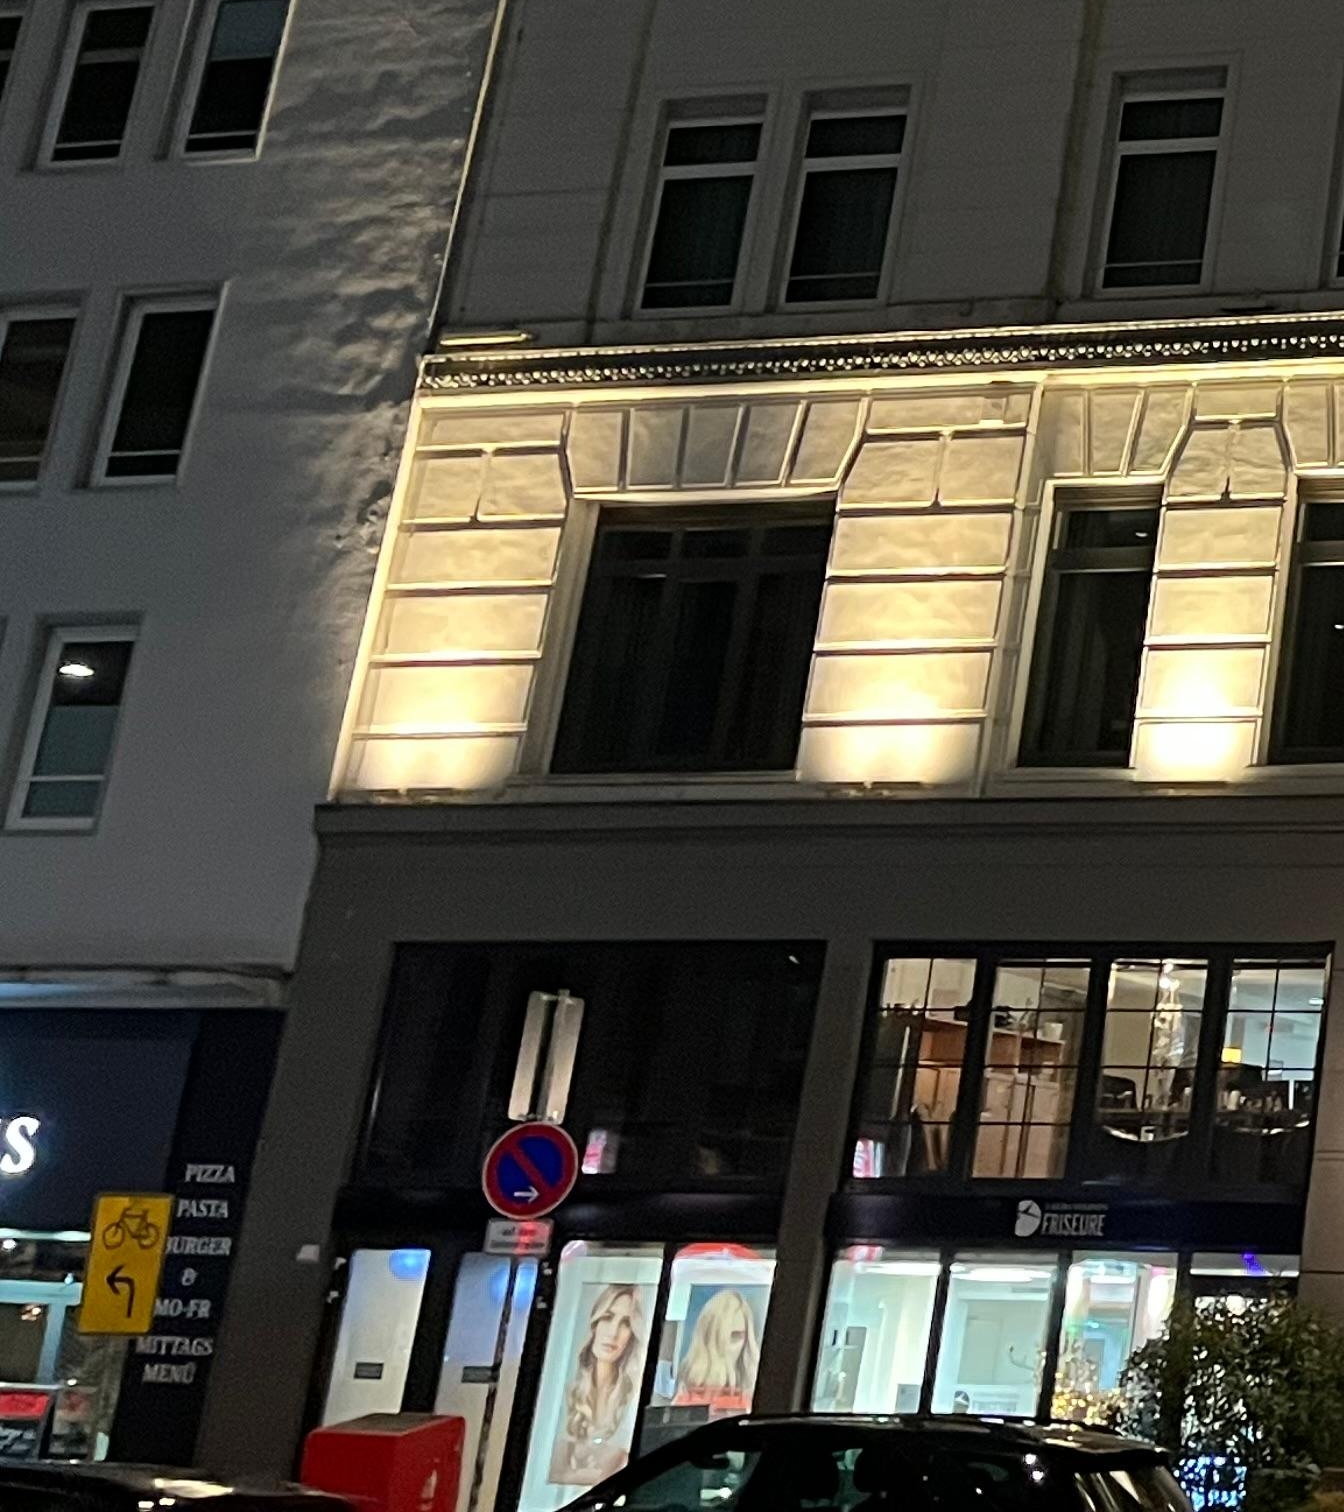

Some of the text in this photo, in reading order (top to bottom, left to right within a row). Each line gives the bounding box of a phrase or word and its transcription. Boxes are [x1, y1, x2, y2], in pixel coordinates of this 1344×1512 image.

[184, 1163, 235, 1183] PIZZA
[176, 1199, 229, 1218] PASTA
[1041, 1213, 1107, 1237] FRISEURE
[153, 1298, 211, 1319] MO-FR
[136, 1336, 214, 1356] MITTAGS
